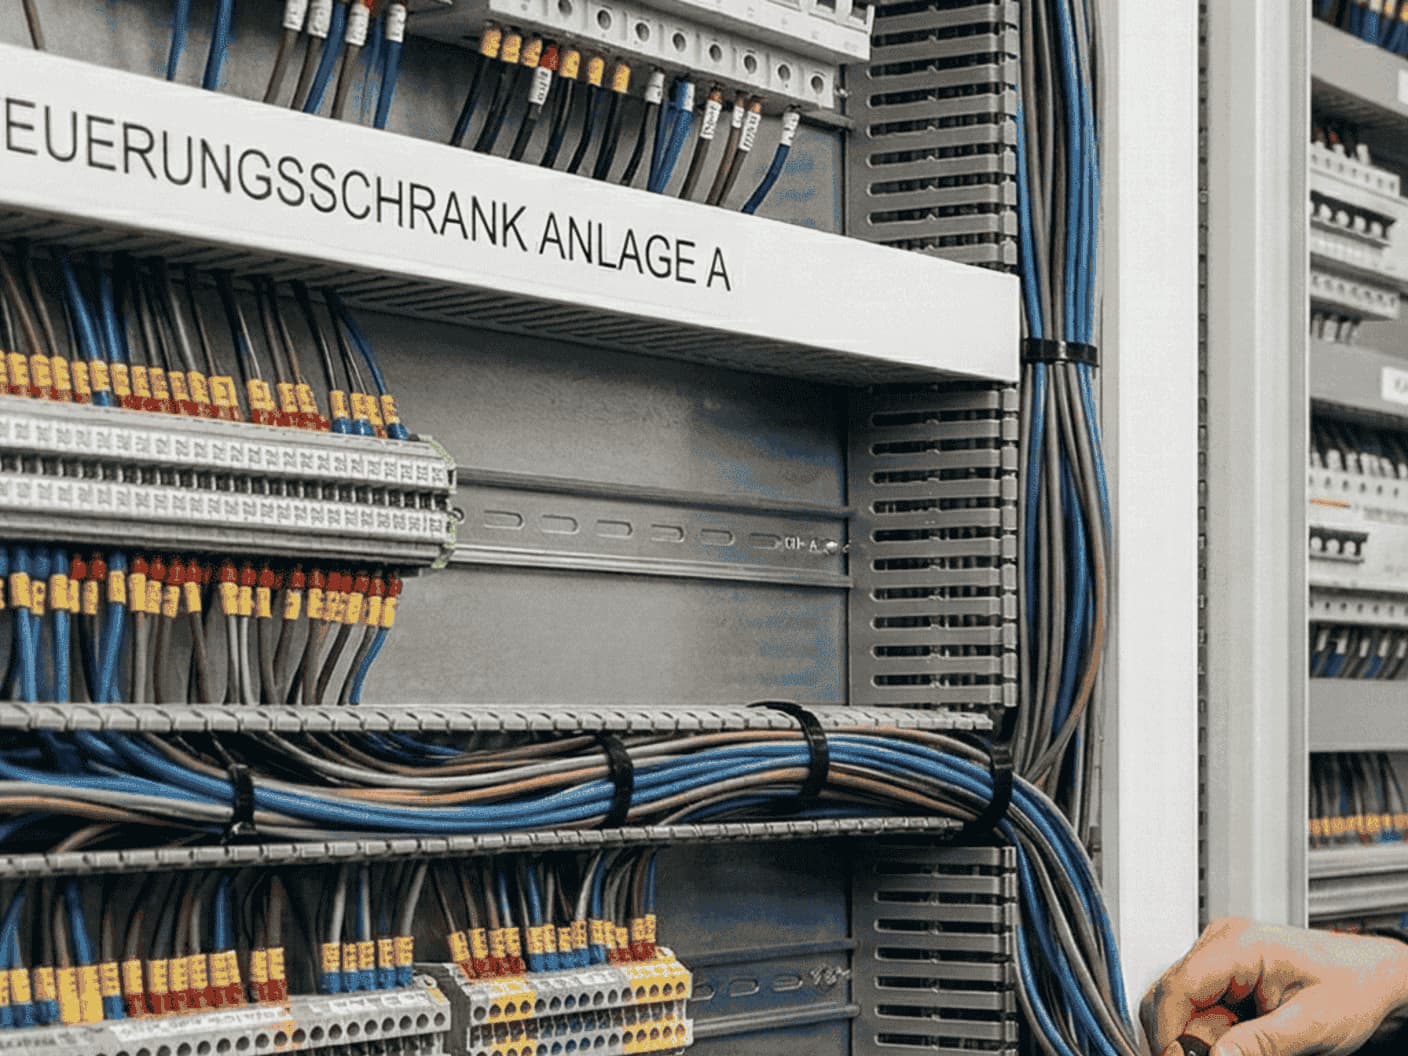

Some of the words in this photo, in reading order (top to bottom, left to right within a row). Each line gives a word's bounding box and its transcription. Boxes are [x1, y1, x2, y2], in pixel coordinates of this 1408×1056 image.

[0, 97, 528, 252] EUERUNGSSCHRANK
[539, 211, 697, 284] ANLAGE
[706, 246, 732, 292] A
